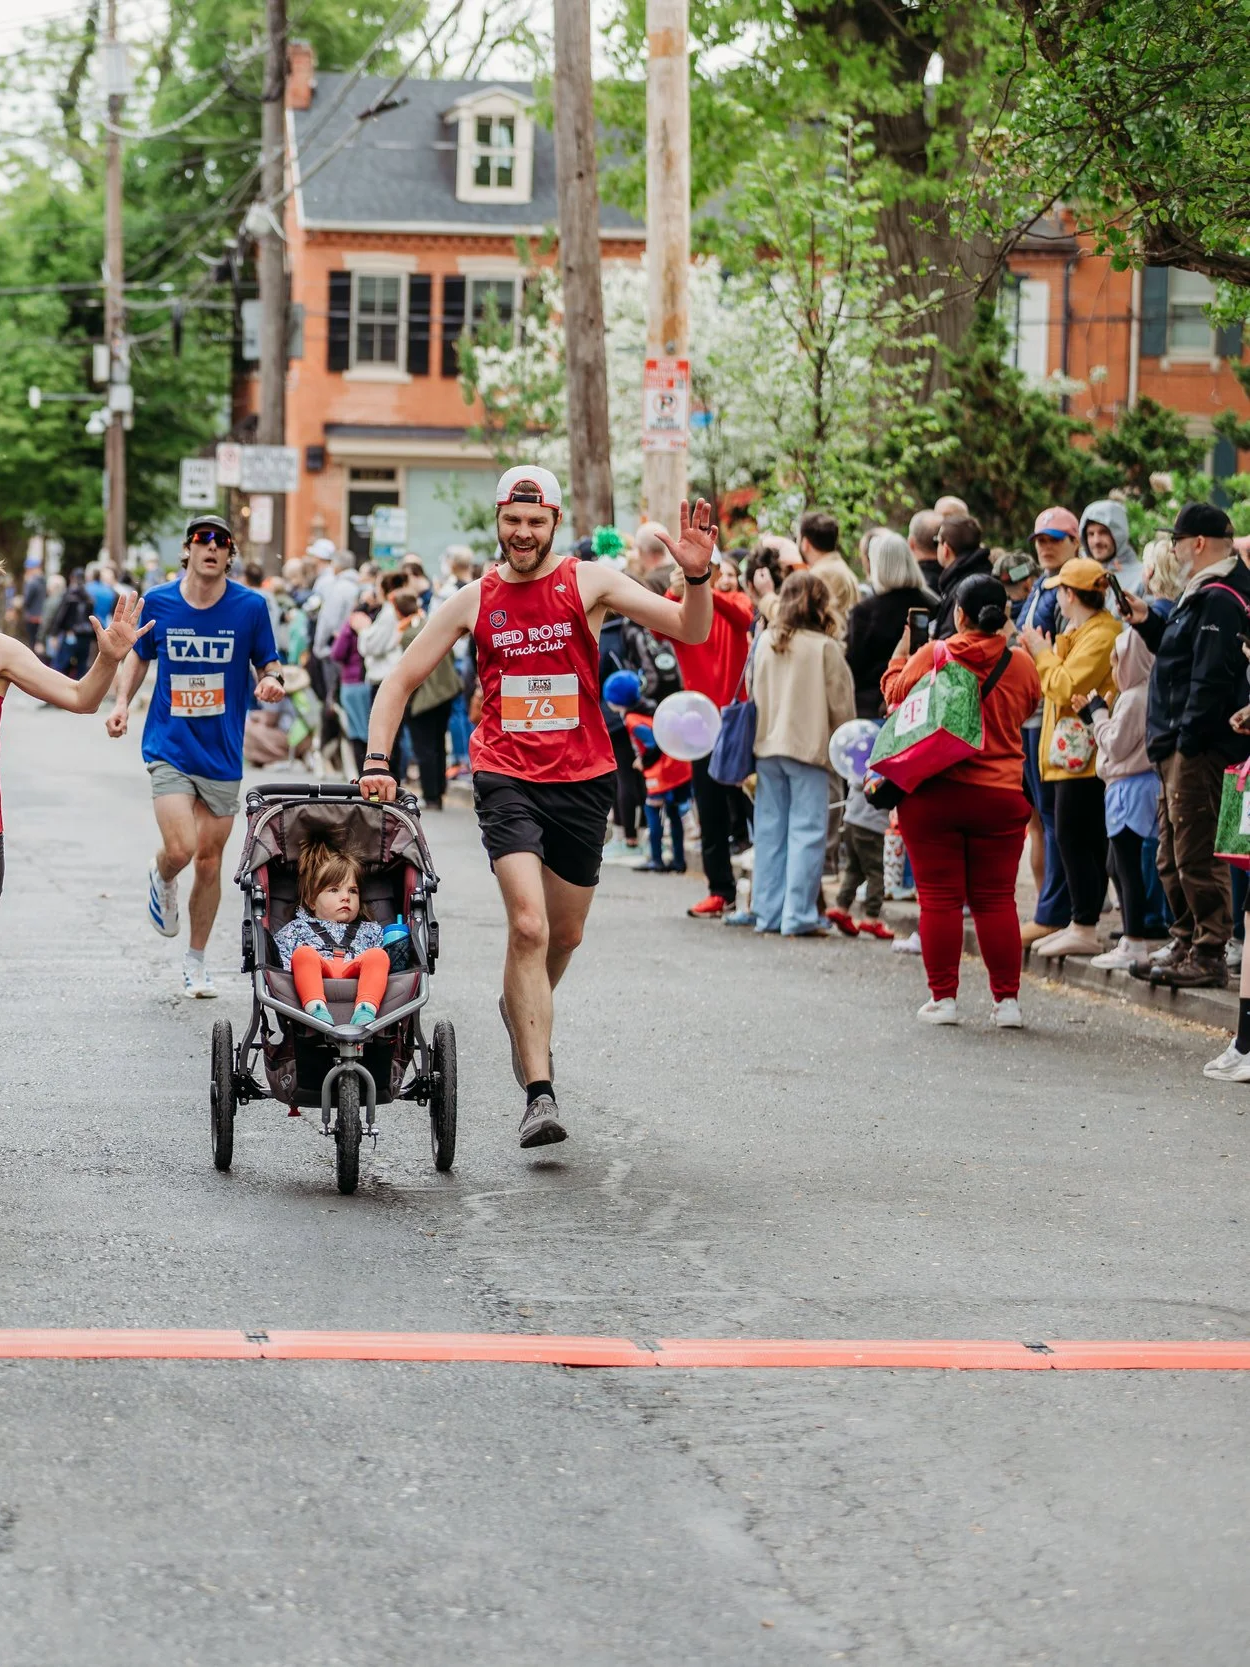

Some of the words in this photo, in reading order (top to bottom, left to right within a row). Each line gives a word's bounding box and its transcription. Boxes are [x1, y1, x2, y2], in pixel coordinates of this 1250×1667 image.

[492, 630, 524, 648] RED
[528, 622, 572, 641] ROSE
[171, 641, 230, 659] TAIT
[503, 644, 538, 658] Track
[538, 639, 566, 652] Club
[180, 691, 215, 706] 1162
[524, 698, 555, 718] 76
